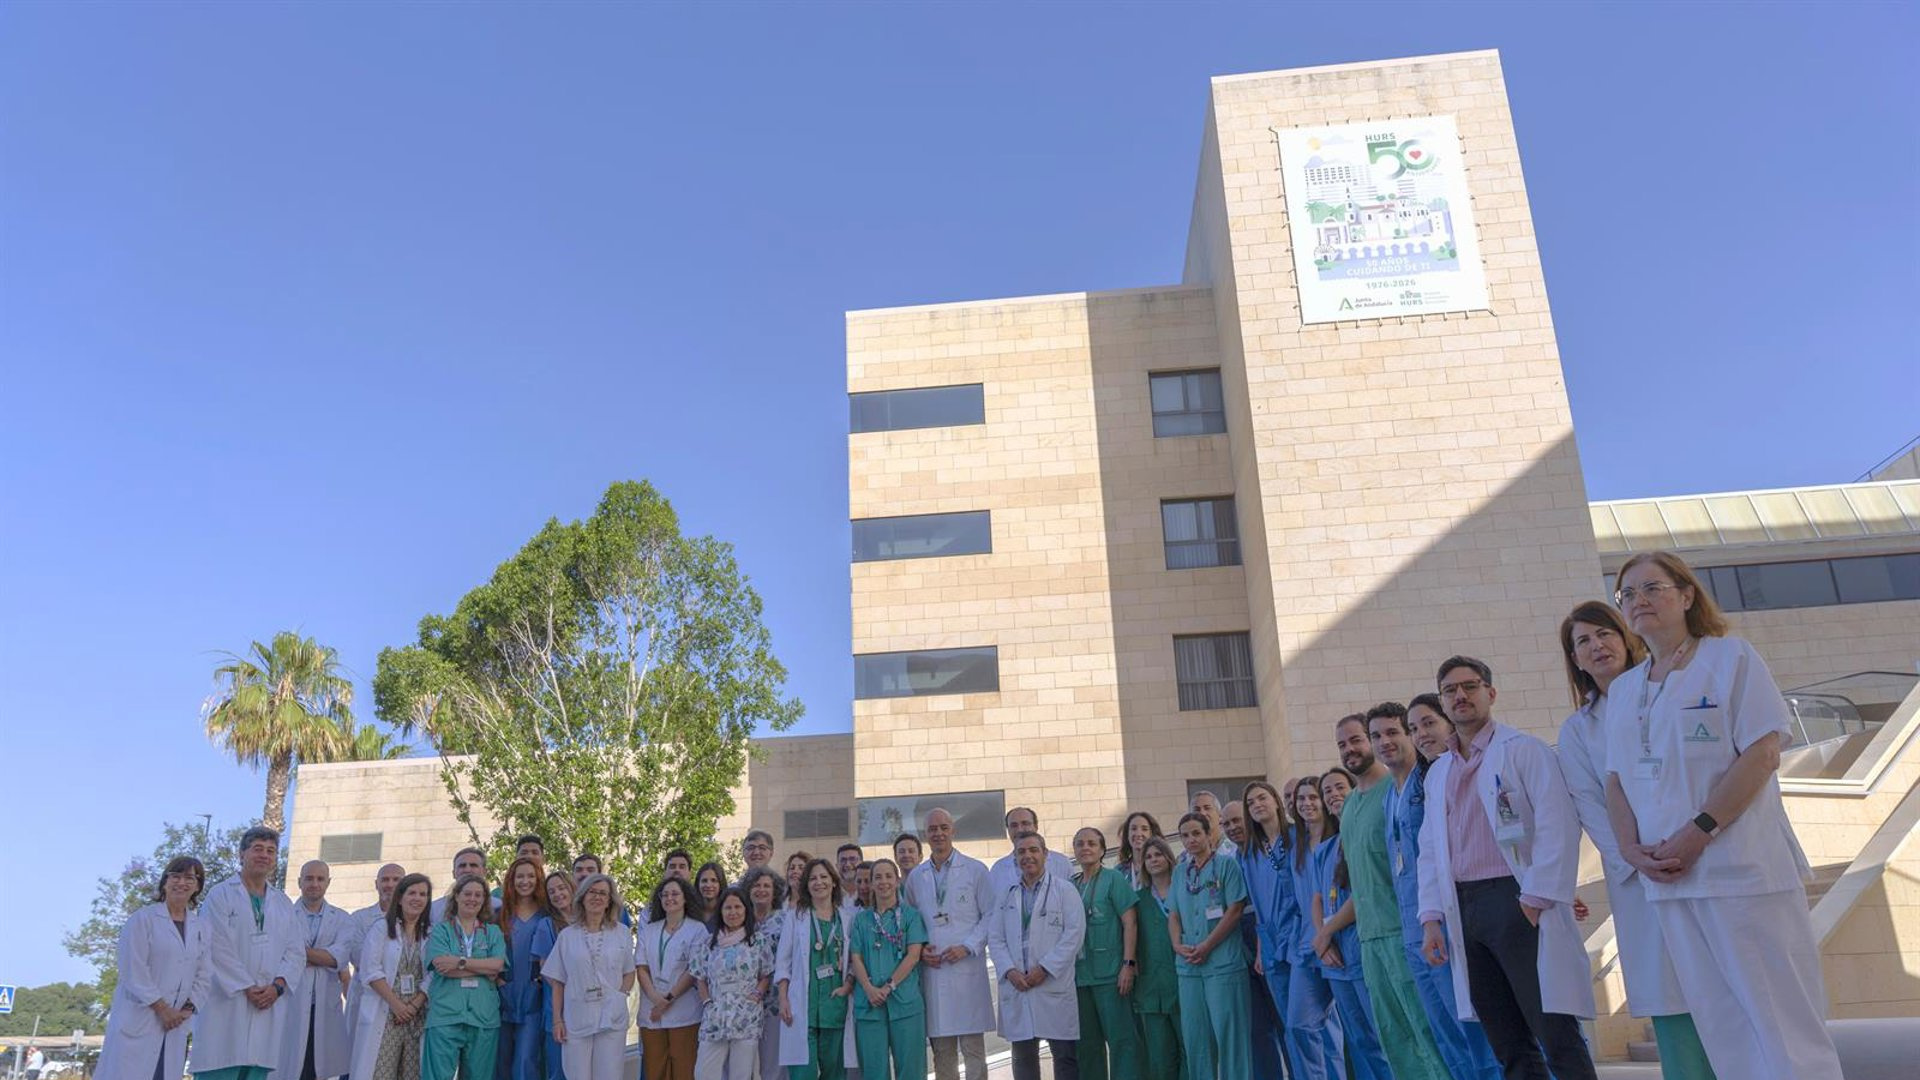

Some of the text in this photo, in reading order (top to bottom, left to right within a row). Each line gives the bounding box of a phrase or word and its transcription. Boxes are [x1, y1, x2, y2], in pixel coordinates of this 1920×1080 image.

[1365, 132, 1396, 142] HURS
[1380, 256, 1409, 266] AÑOS
[1346, 262, 1431, 276] CUIDANDO DE TI
